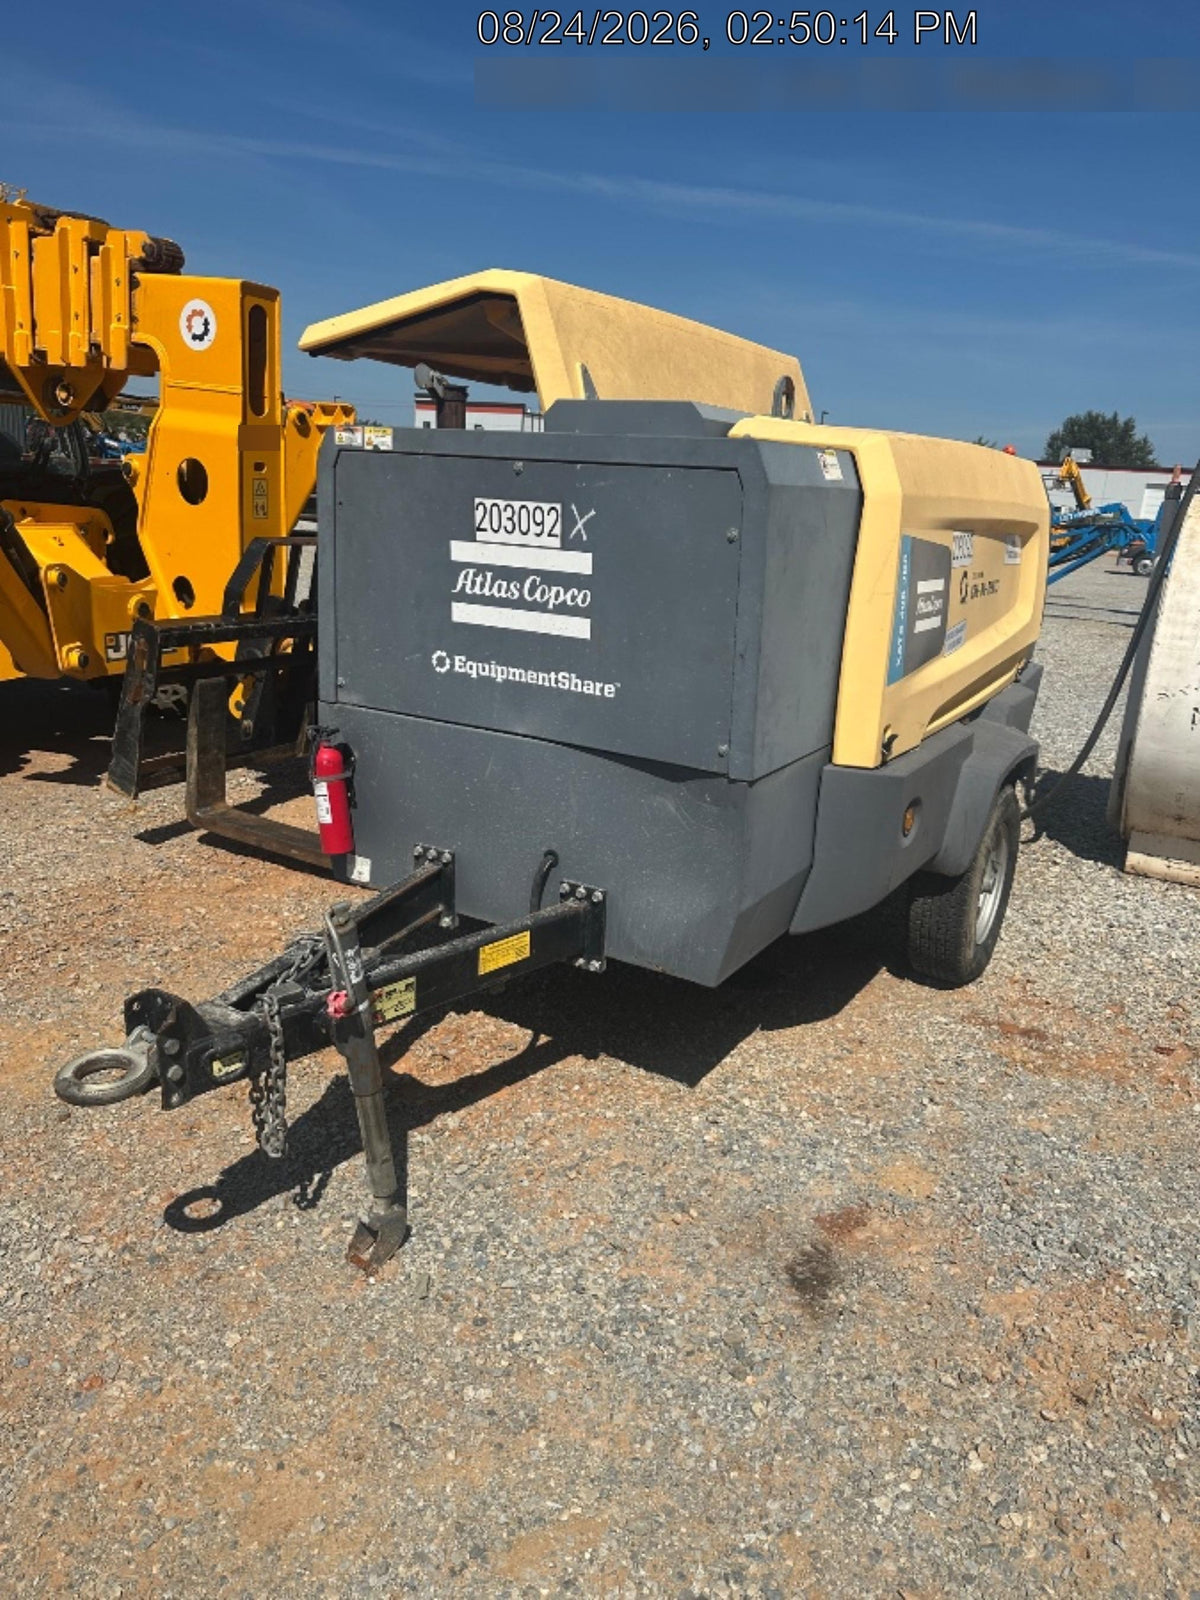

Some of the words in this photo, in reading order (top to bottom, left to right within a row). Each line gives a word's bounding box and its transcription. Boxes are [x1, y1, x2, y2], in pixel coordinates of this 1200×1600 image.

[475, 501, 560, 538] 203092
[451, 568, 520, 600] Atlas
[524, 575, 591, 609] Copco
